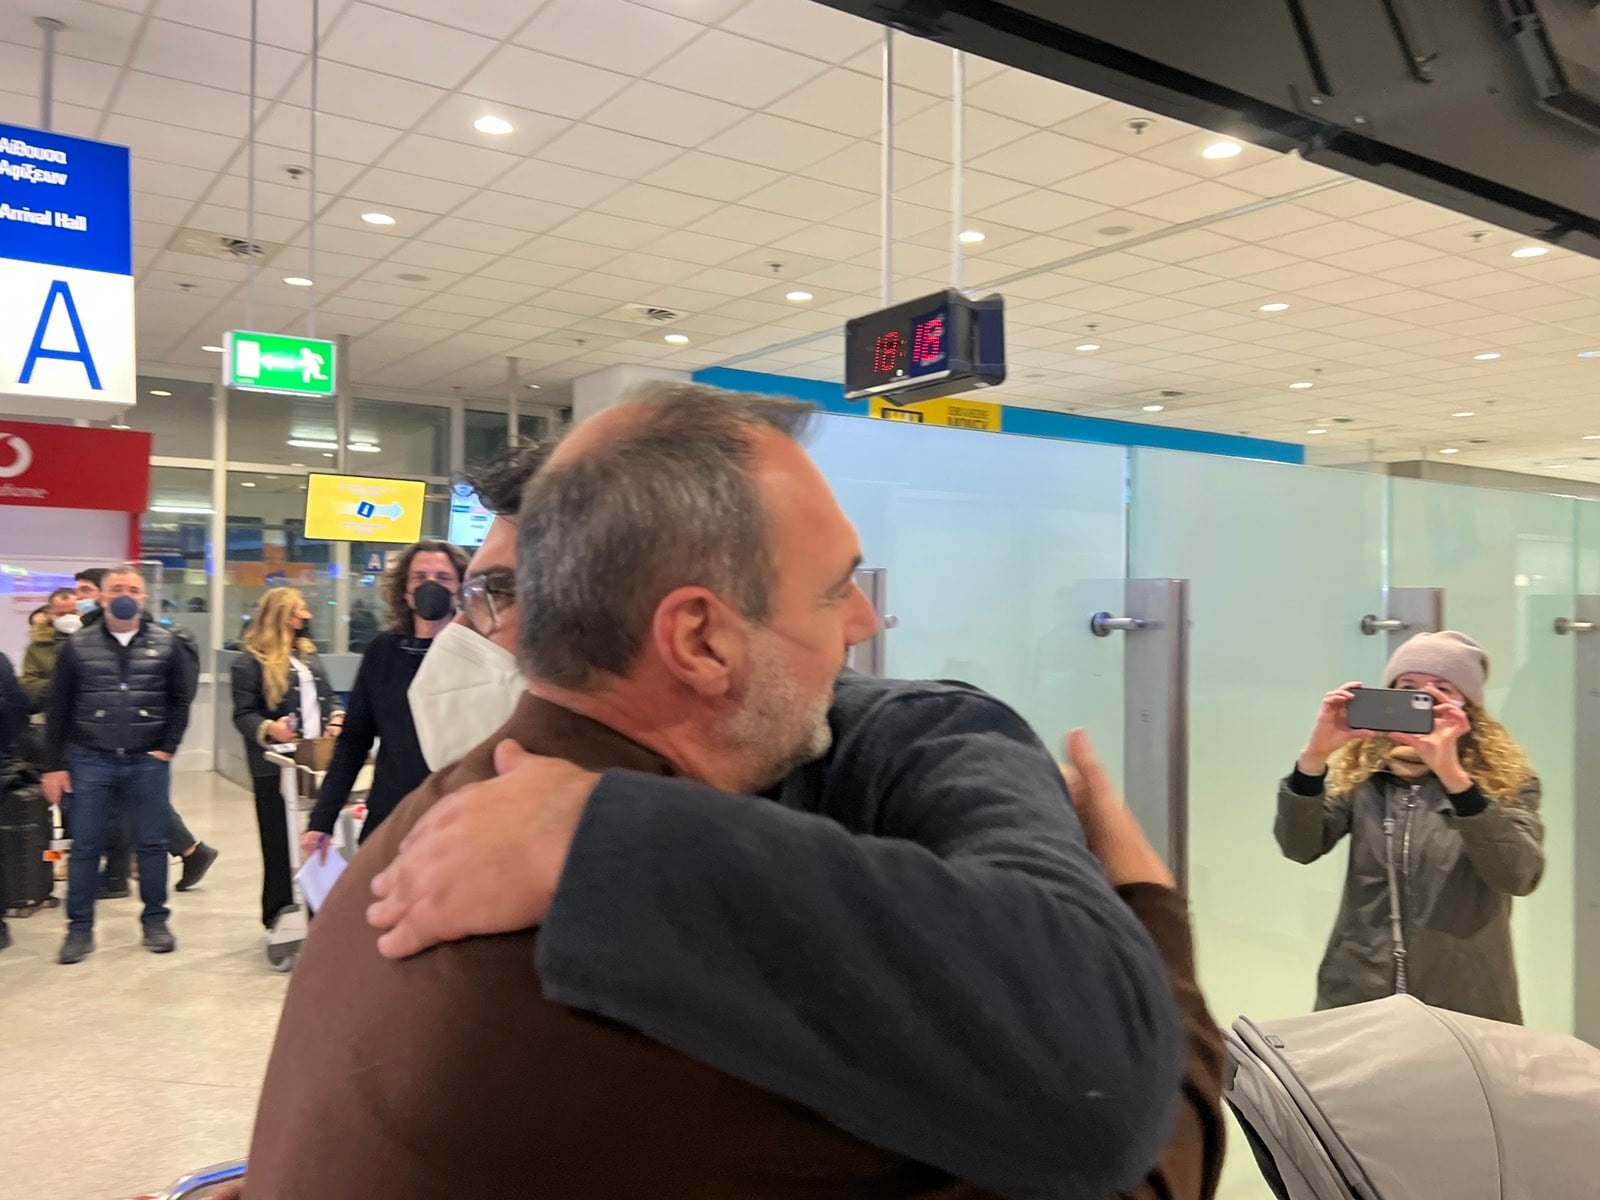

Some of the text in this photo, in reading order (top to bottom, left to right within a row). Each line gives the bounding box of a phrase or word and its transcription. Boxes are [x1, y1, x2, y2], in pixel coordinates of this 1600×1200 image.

[0, 203, 87, 232] Arrival Hall
[18, 279, 103, 390] A
[873, 318, 944, 374] 18:18
